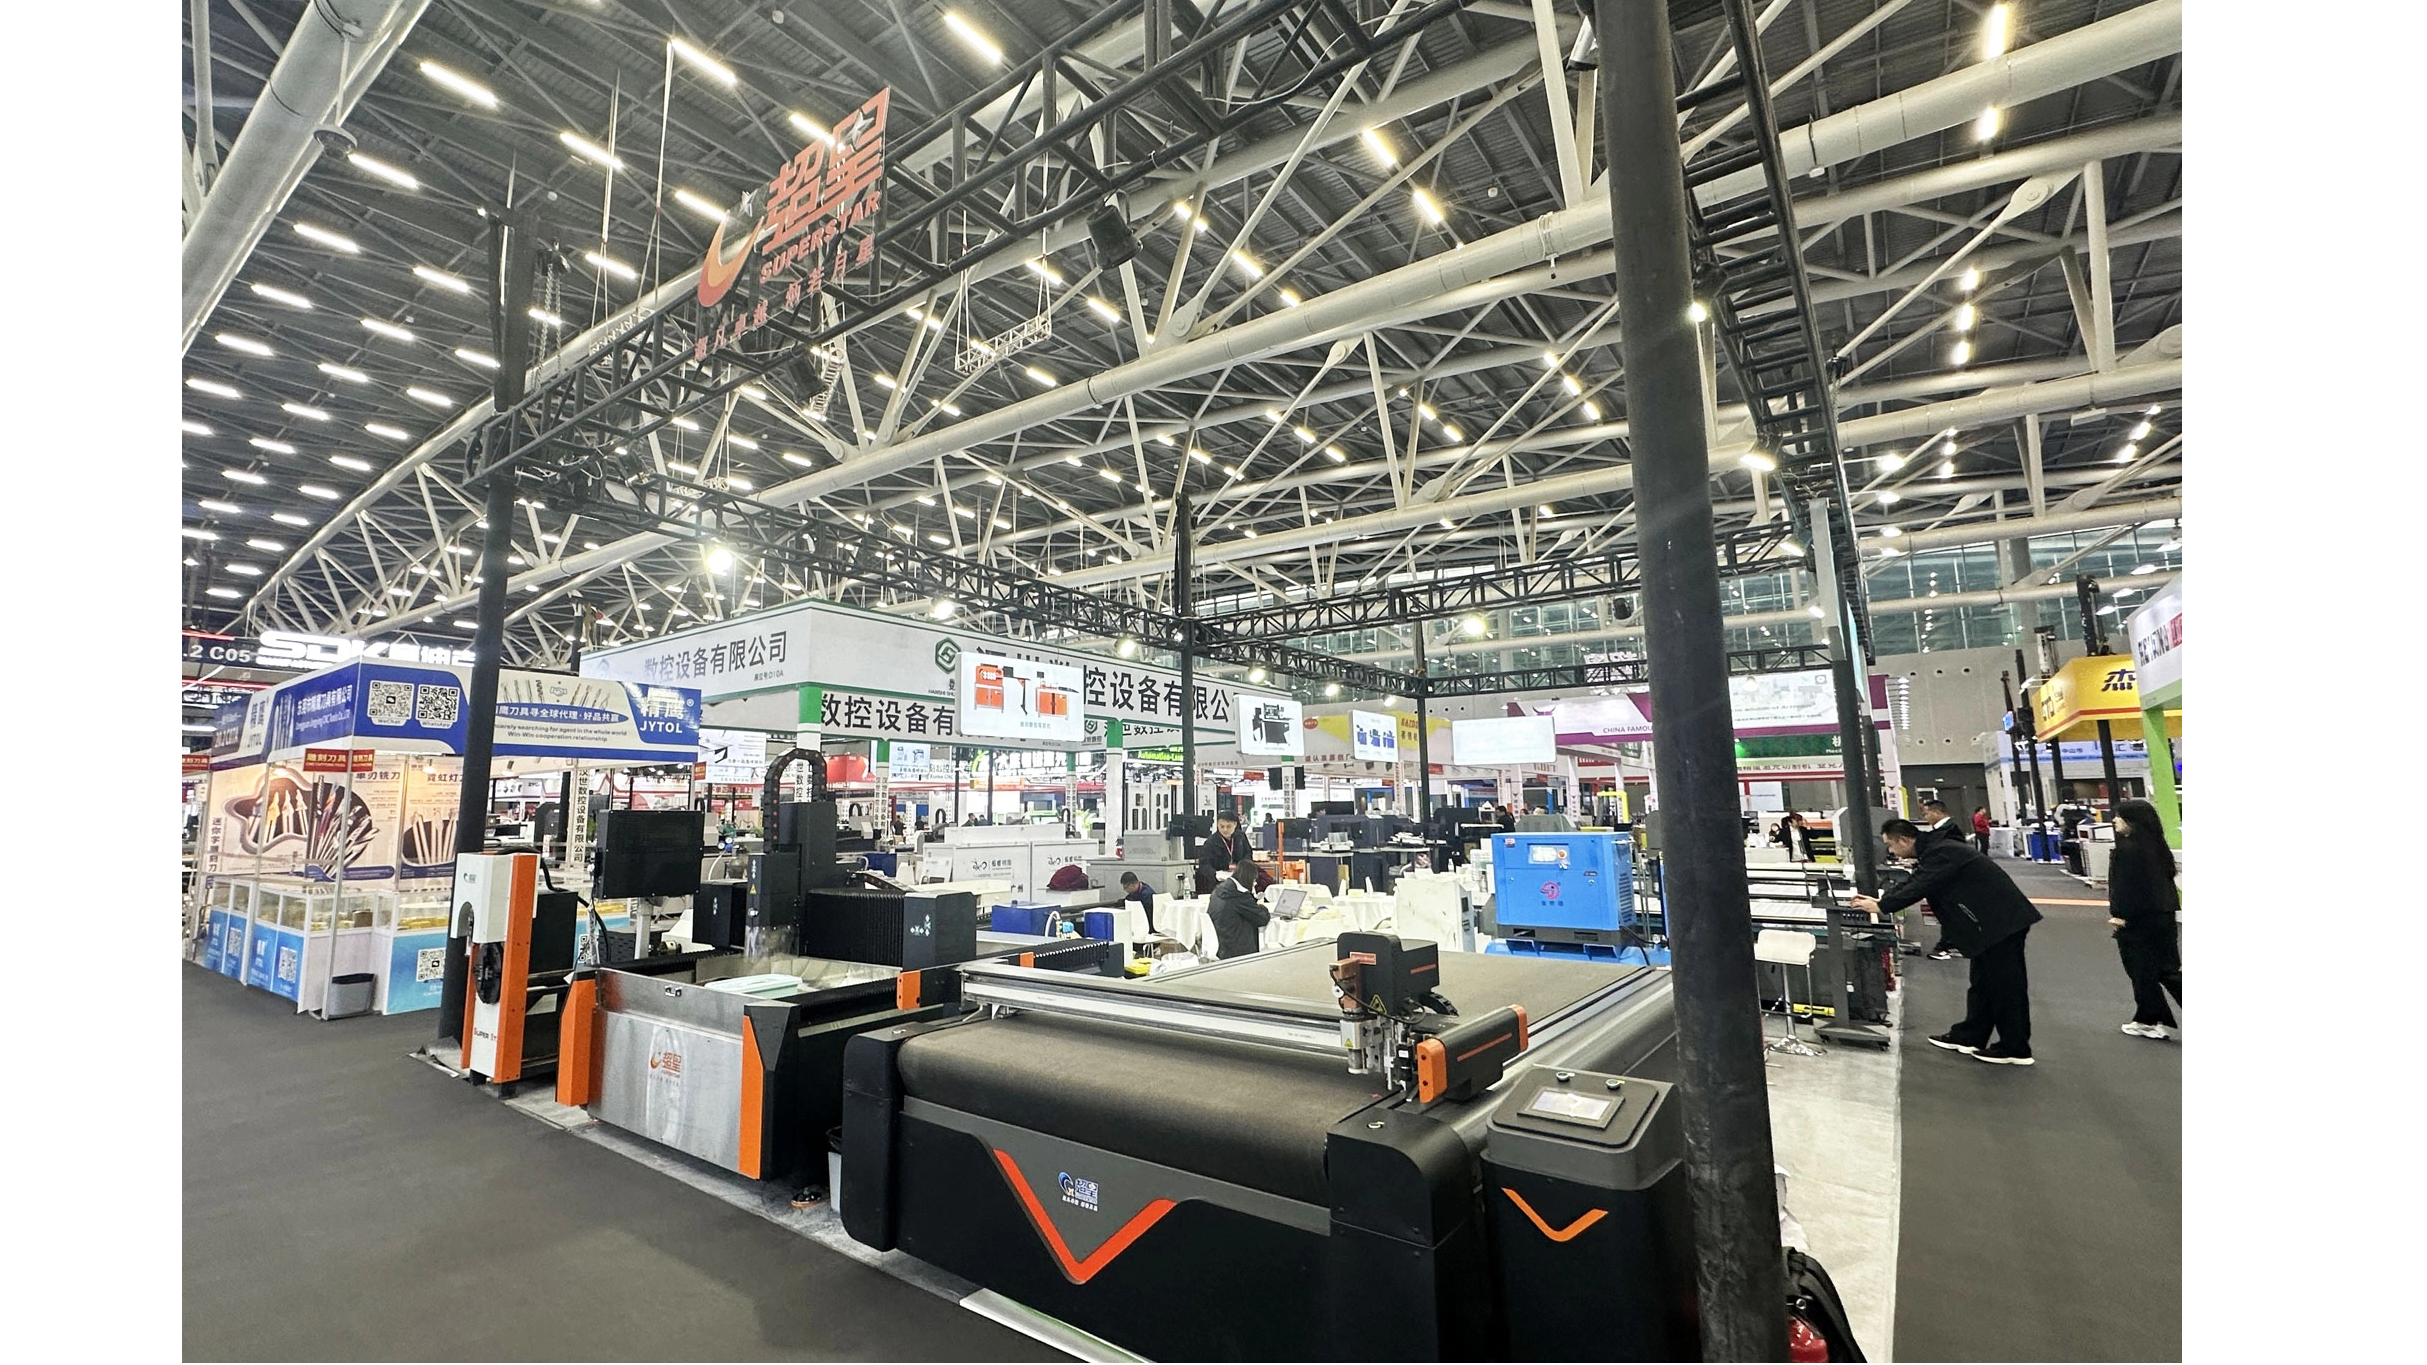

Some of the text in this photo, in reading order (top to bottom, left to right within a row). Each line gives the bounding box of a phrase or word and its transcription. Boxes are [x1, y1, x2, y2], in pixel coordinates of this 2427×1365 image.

[763, 85, 889, 255] 超星
[760, 191, 880, 284] SUPERSTAR
[209, 646, 250, 662] C05
[258, 630, 391, 663] SDK
[639, 720, 683, 733] JYTOL
[427, 773, 463, 782] 霓虹灯
